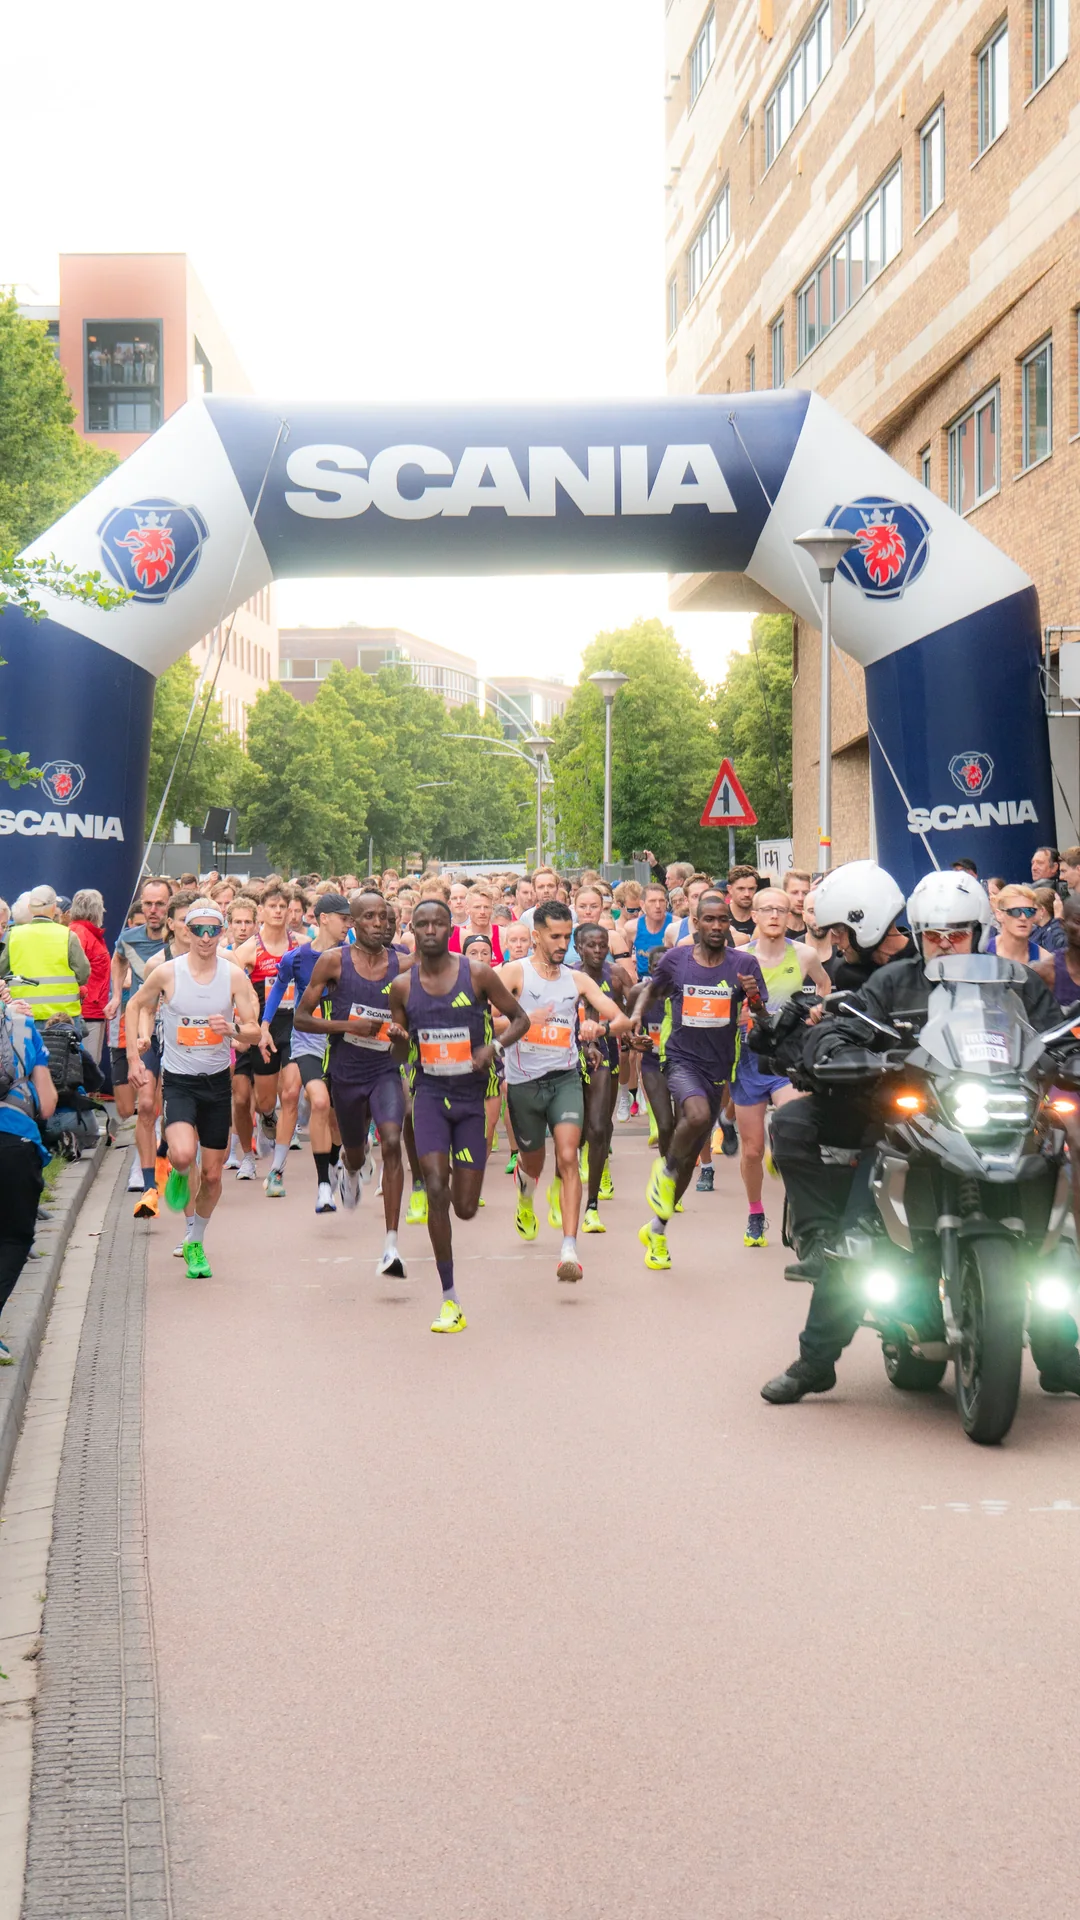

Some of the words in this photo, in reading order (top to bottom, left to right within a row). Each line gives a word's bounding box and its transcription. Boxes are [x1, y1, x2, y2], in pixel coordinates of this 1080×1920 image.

[285, 444, 738, 520] SCANIA
[907, 800, 1039, 834] SCANIA
[0, 809, 124, 841] SCANIA
[697, 988, 729, 997] SCANIA
[701, 999, 711, 1011] 2
[196, 1028, 206, 1040] 3
[540, 1026, 558, 1040] 10
